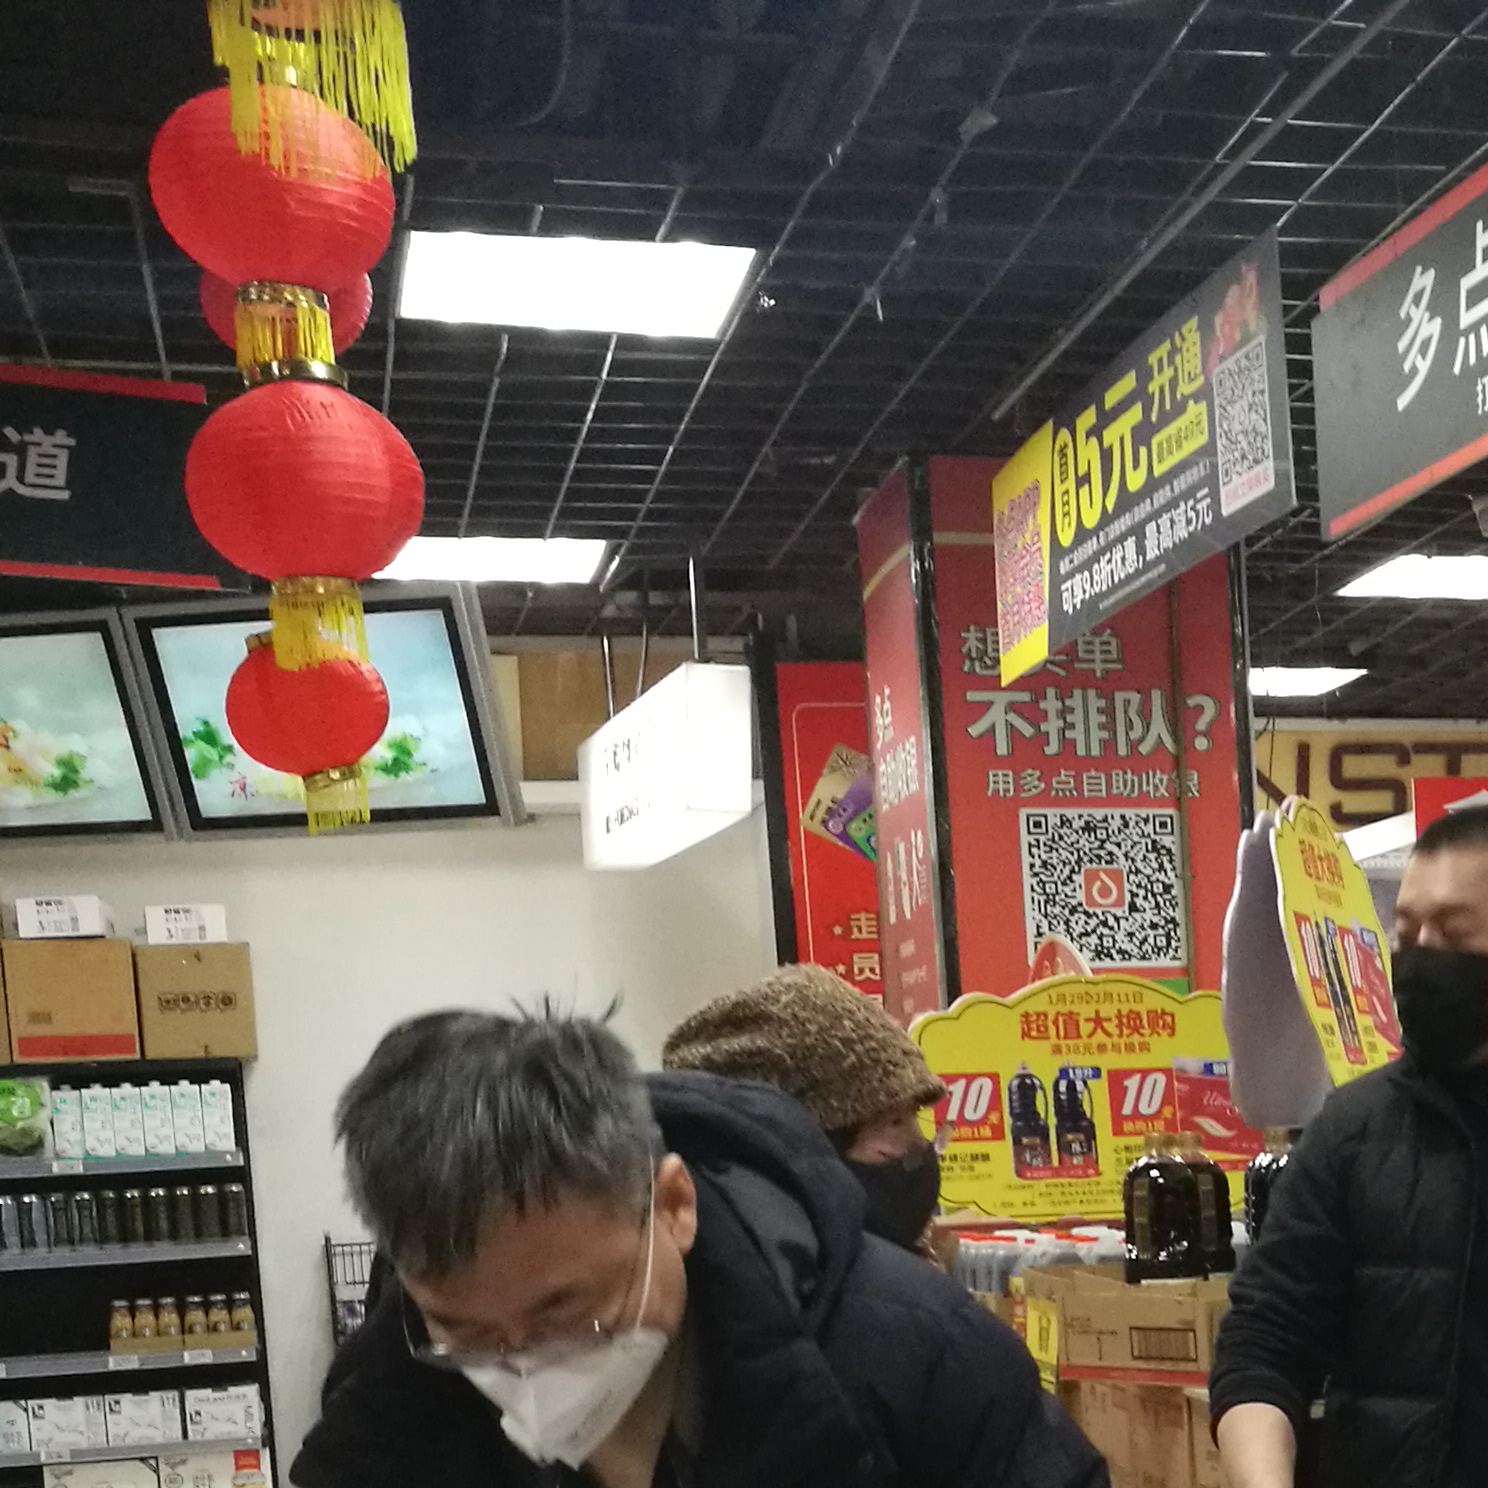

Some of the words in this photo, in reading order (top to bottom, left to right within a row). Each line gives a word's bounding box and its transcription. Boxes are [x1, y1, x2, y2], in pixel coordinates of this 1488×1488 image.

[1019, 1008, 1176, 1041] 超值大换购
[946, 1076, 993, 1122] 10
[1121, 1071, 1167, 1117] 10
